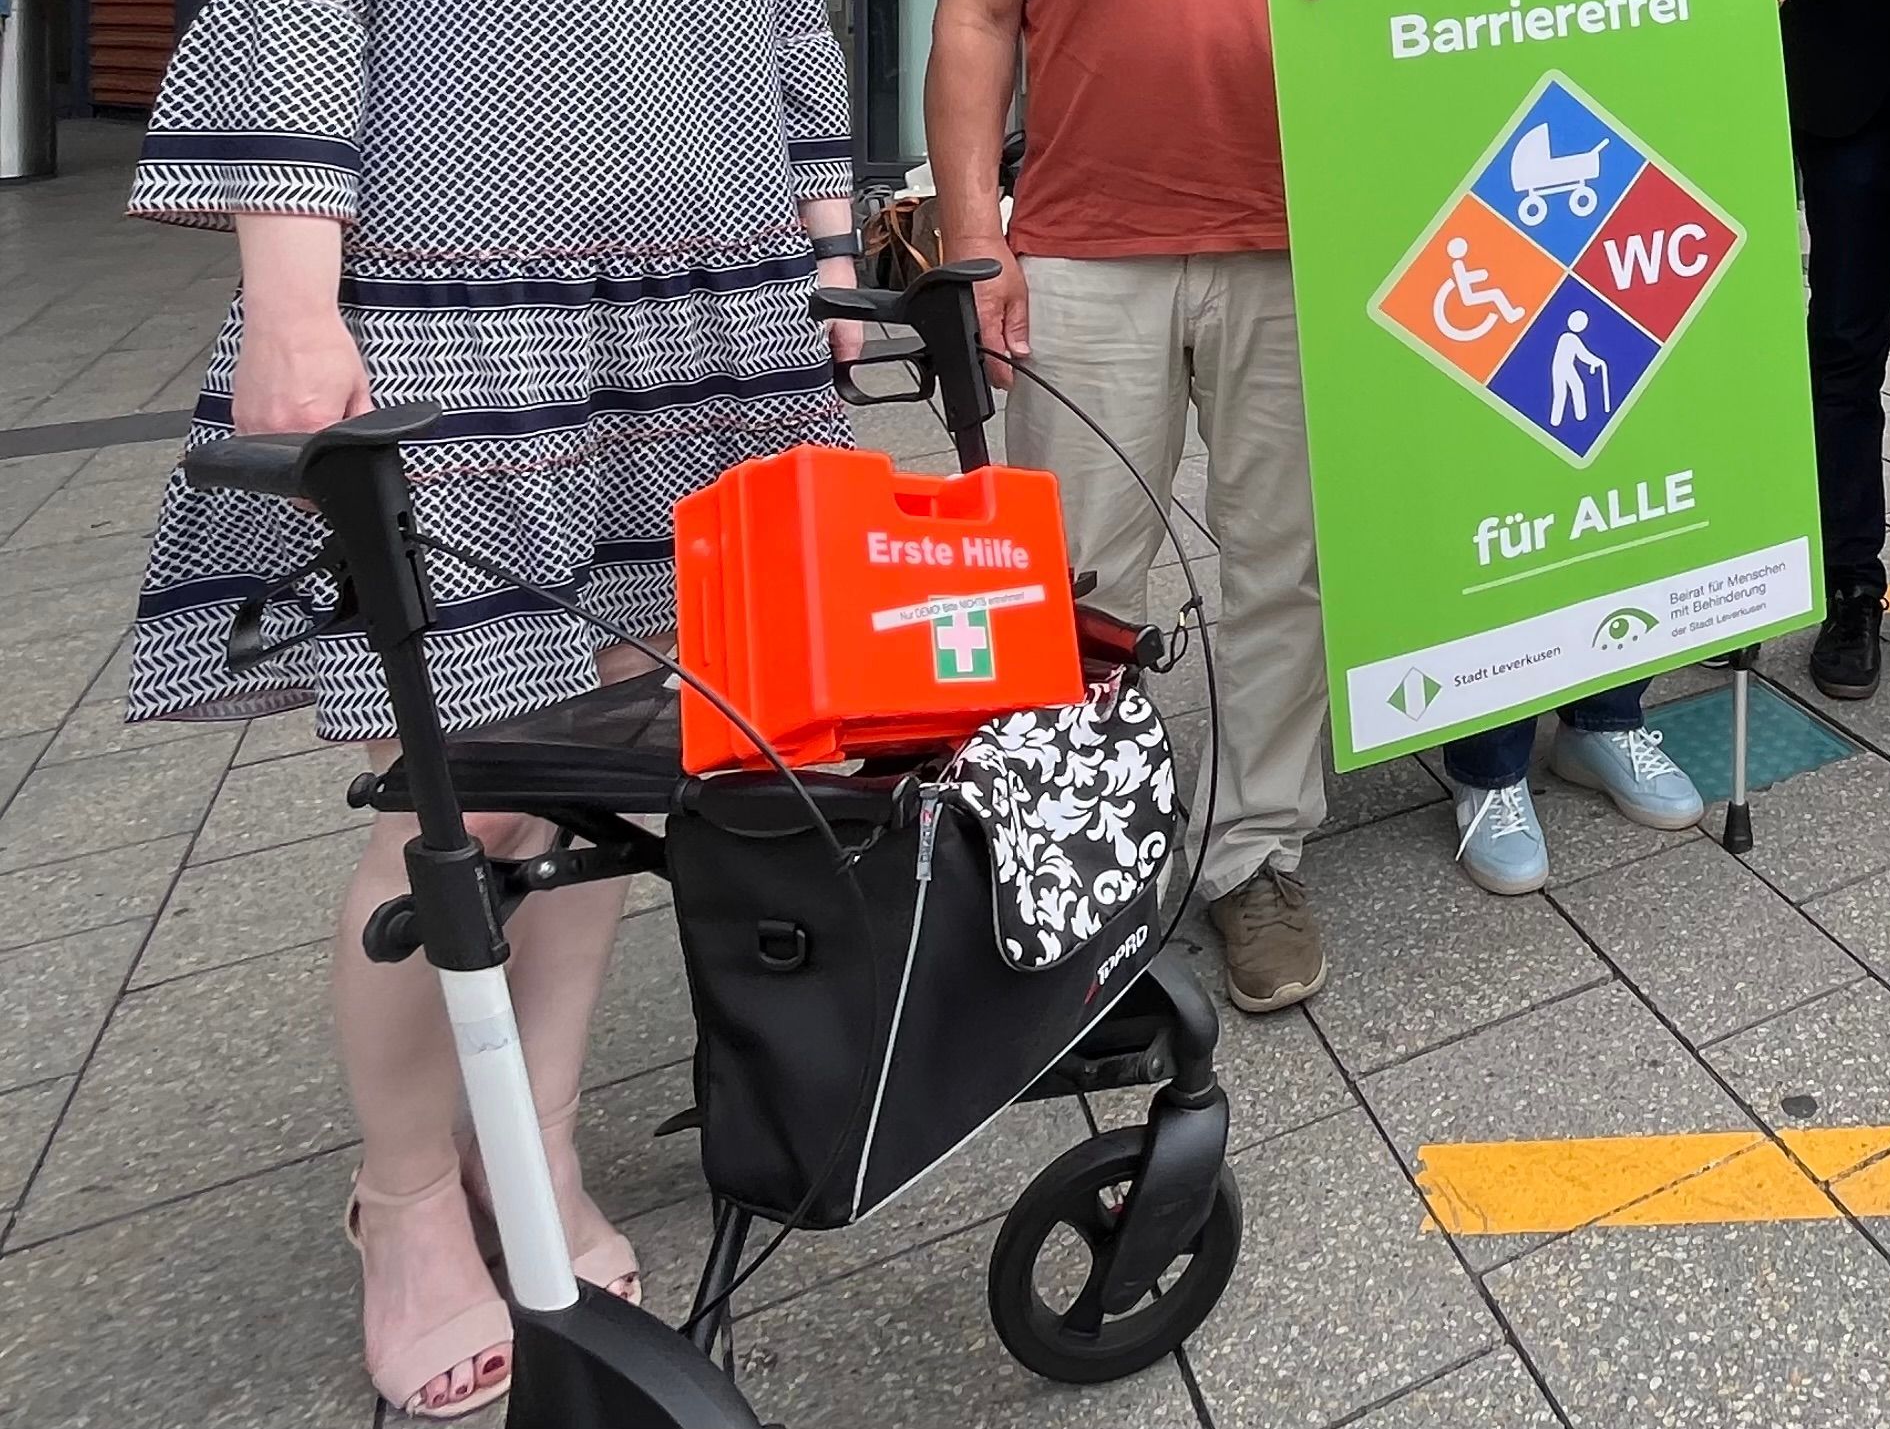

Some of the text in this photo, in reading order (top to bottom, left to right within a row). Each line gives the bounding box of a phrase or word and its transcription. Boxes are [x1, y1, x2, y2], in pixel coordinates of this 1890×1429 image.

[1603, 222, 1709, 291] WC
[1472, 469, 1697, 566] für ALLE
[867, 531, 1029, 570] Erste Hilfe
[1670, 562, 1786, 604] Beirat für Menschen
[1670, 583, 1766, 620] mit Behinderung
[1671, 602, 1767, 637] der Stadt Leverkusen
[1454, 646, 1561, 687] Stadt Leverkusen
[1097, 924, 1149, 986] TOPRO
